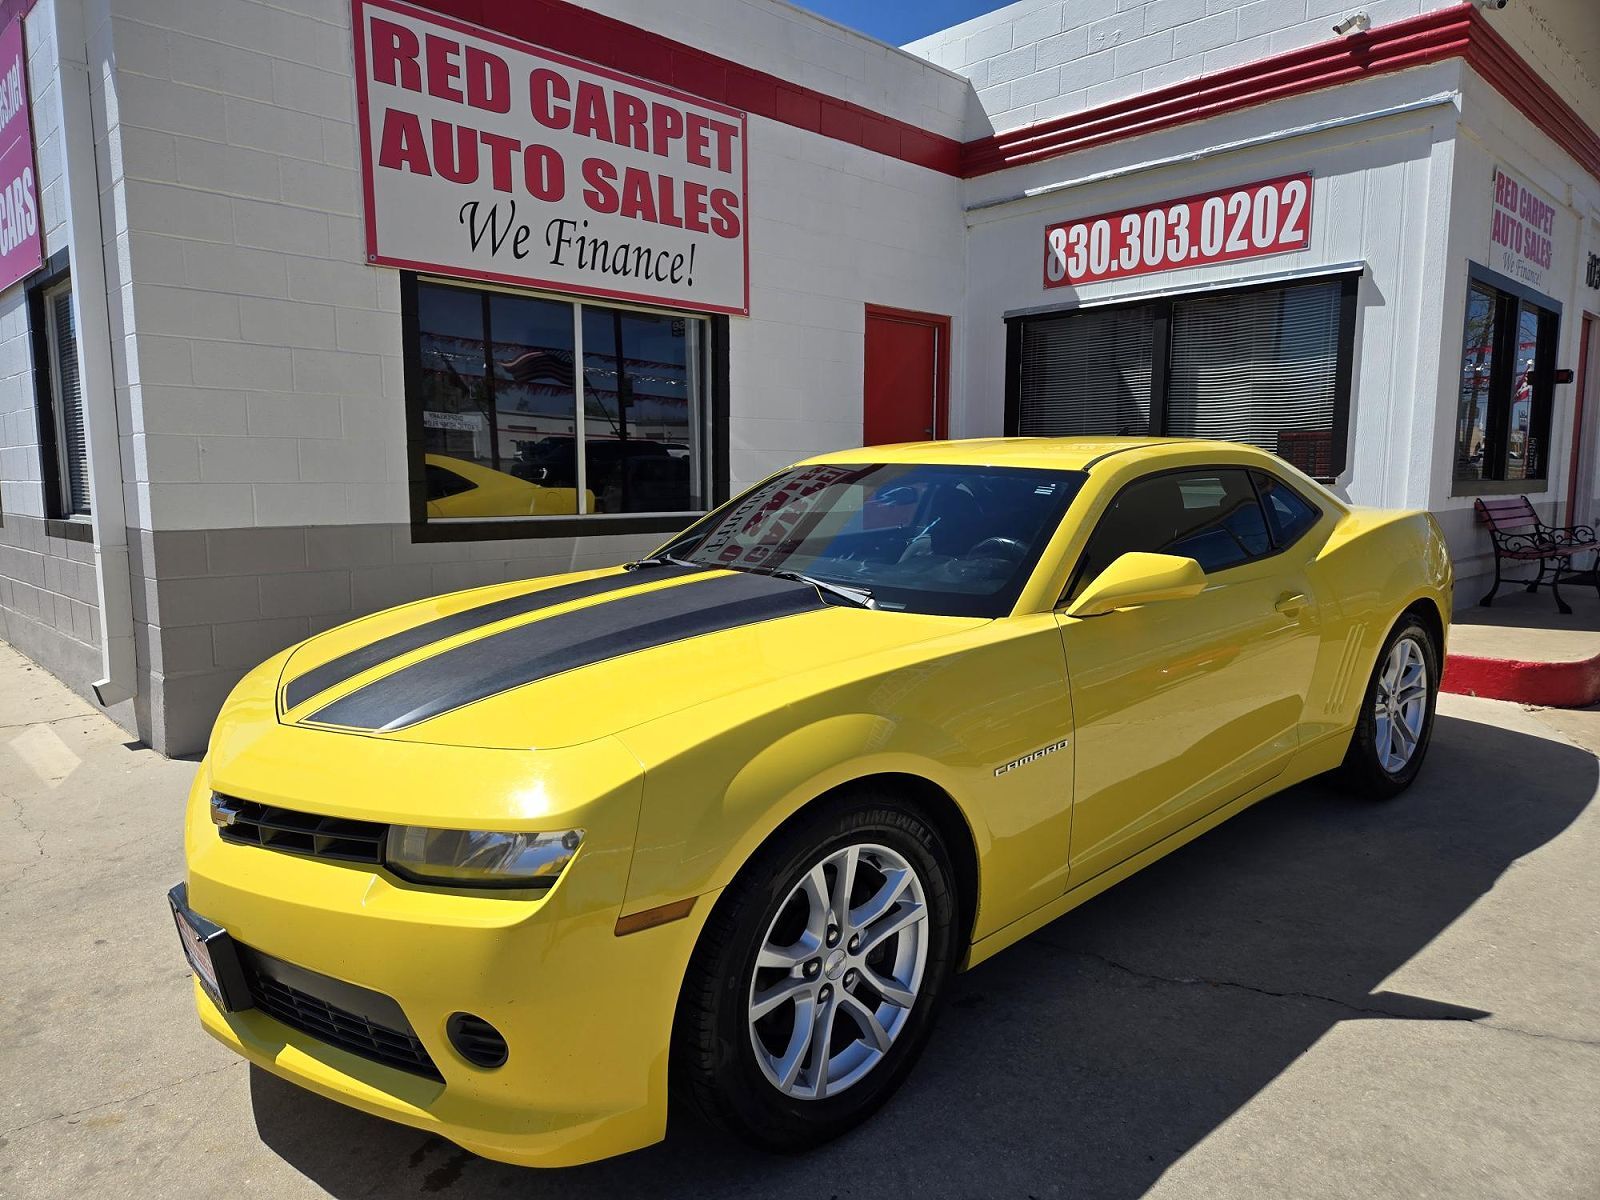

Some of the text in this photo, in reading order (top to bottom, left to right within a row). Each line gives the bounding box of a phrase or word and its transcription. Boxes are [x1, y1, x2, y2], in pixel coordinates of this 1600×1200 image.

[369, 16, 740, 174] RED CARPET
[0, 166, 36, 257] CARS
[378, 106, 741, 240] AUTO SALES
[1495, 171, 1556, 237] RED CARPET
[458, 199, 697, 287] We Finance!
[1046, 179, 1308, 283] 830.303.0202
[1491, 208, 1553, 271] AUTO SALES
[993, 738, 1069, 777] CAMARO
